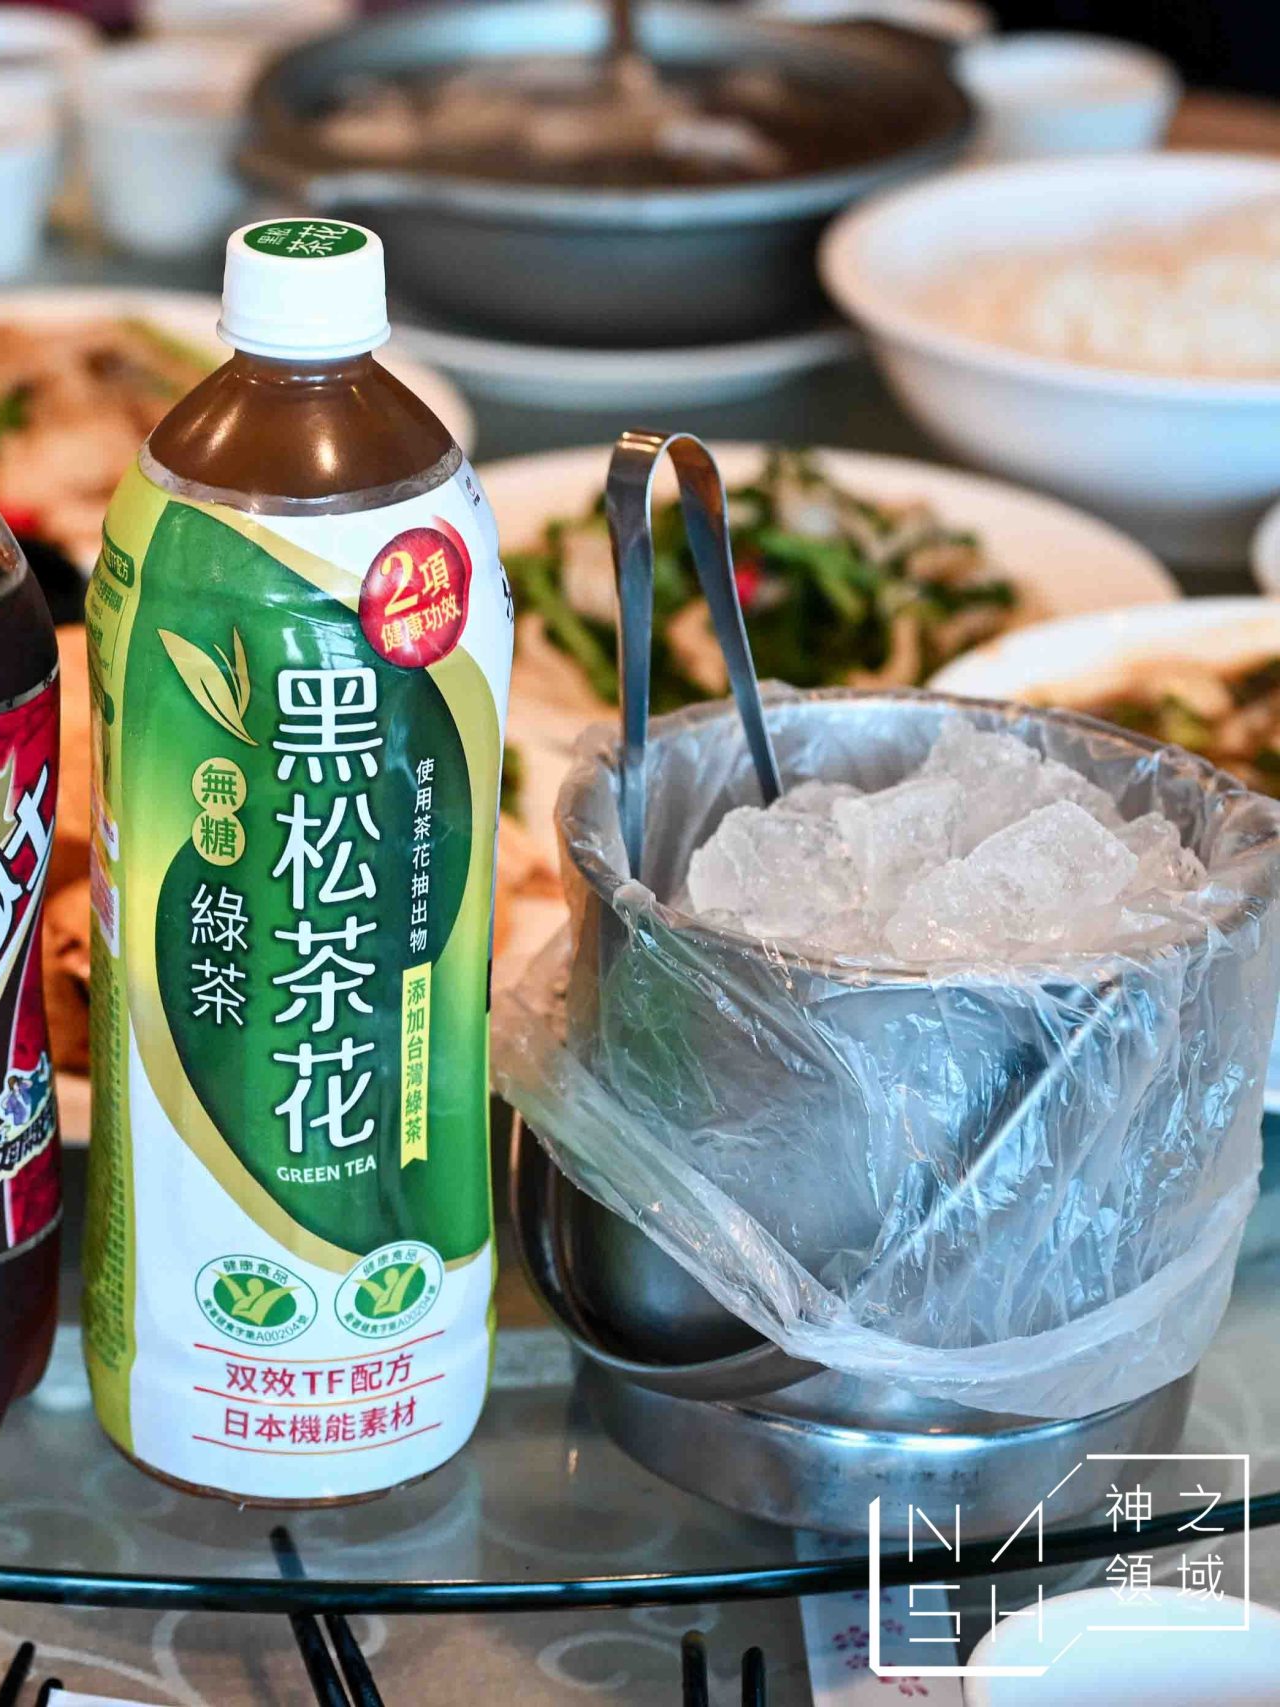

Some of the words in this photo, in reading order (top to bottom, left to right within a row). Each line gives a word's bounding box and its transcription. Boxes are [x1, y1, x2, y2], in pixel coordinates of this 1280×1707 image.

[285, 224, 349, 256] 茶花
[379, 592, 462, 652] 健康功效
[198, 763, 238, 861] 無糖
[409, 757, 436, 955] 使用茶花抽出物
[271, 665, 385, 1154] 黑松茶花
[190, 883, 249, 1027] 綠茶
[406, 977, 427, 1145] 添加台灣綠茶
[276, 1164, 341, 1184] GREEN
[344, 1155, 377, 1178] TEA
[223, 1259, 289, 1285] 健康食品
[225, 1353, 415, 1398] 双效TF配方
[224, 1396, 417, 1445] 日本機能素材
